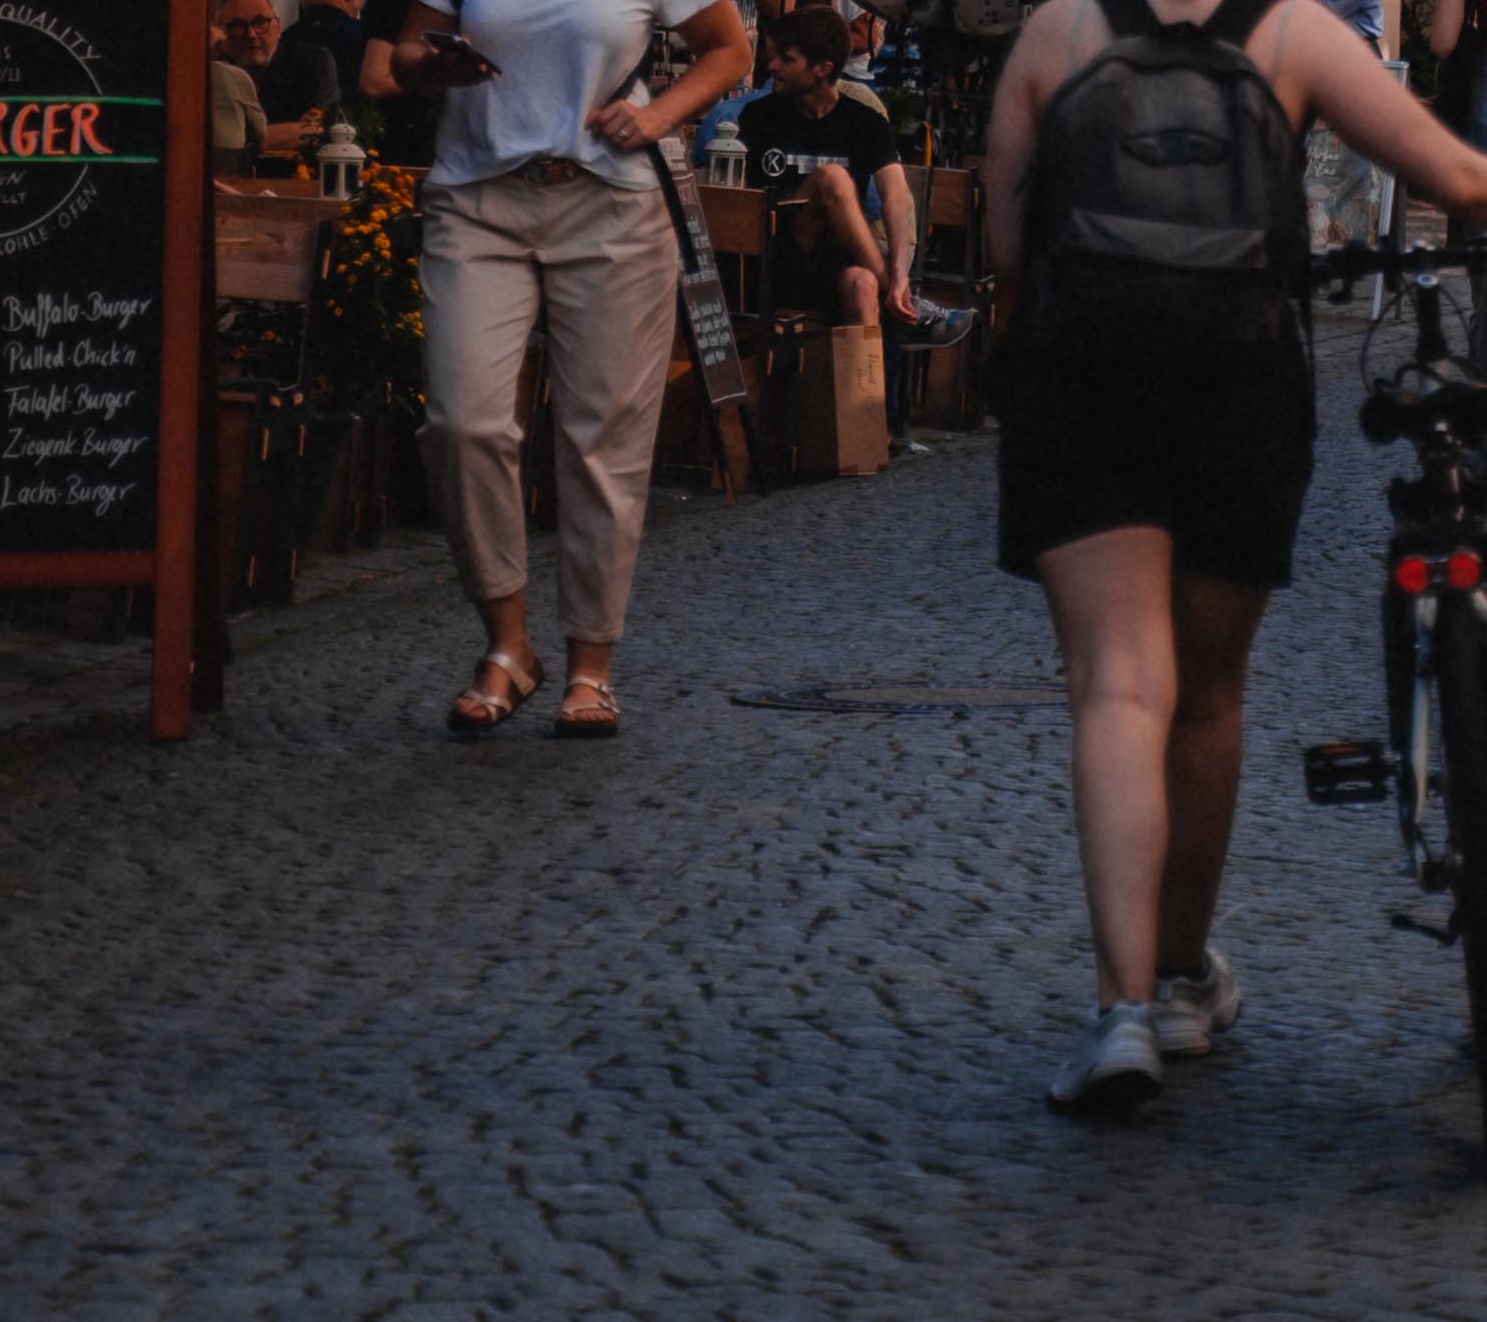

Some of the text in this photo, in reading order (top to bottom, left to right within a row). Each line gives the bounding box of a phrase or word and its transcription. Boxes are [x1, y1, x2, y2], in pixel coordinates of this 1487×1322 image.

[0, 291, 153, 339] Buffalo-Burger
[3, 383, 137, 422] Falafel-Burger
[0, 474, 137, 517] Lachs-Burger
